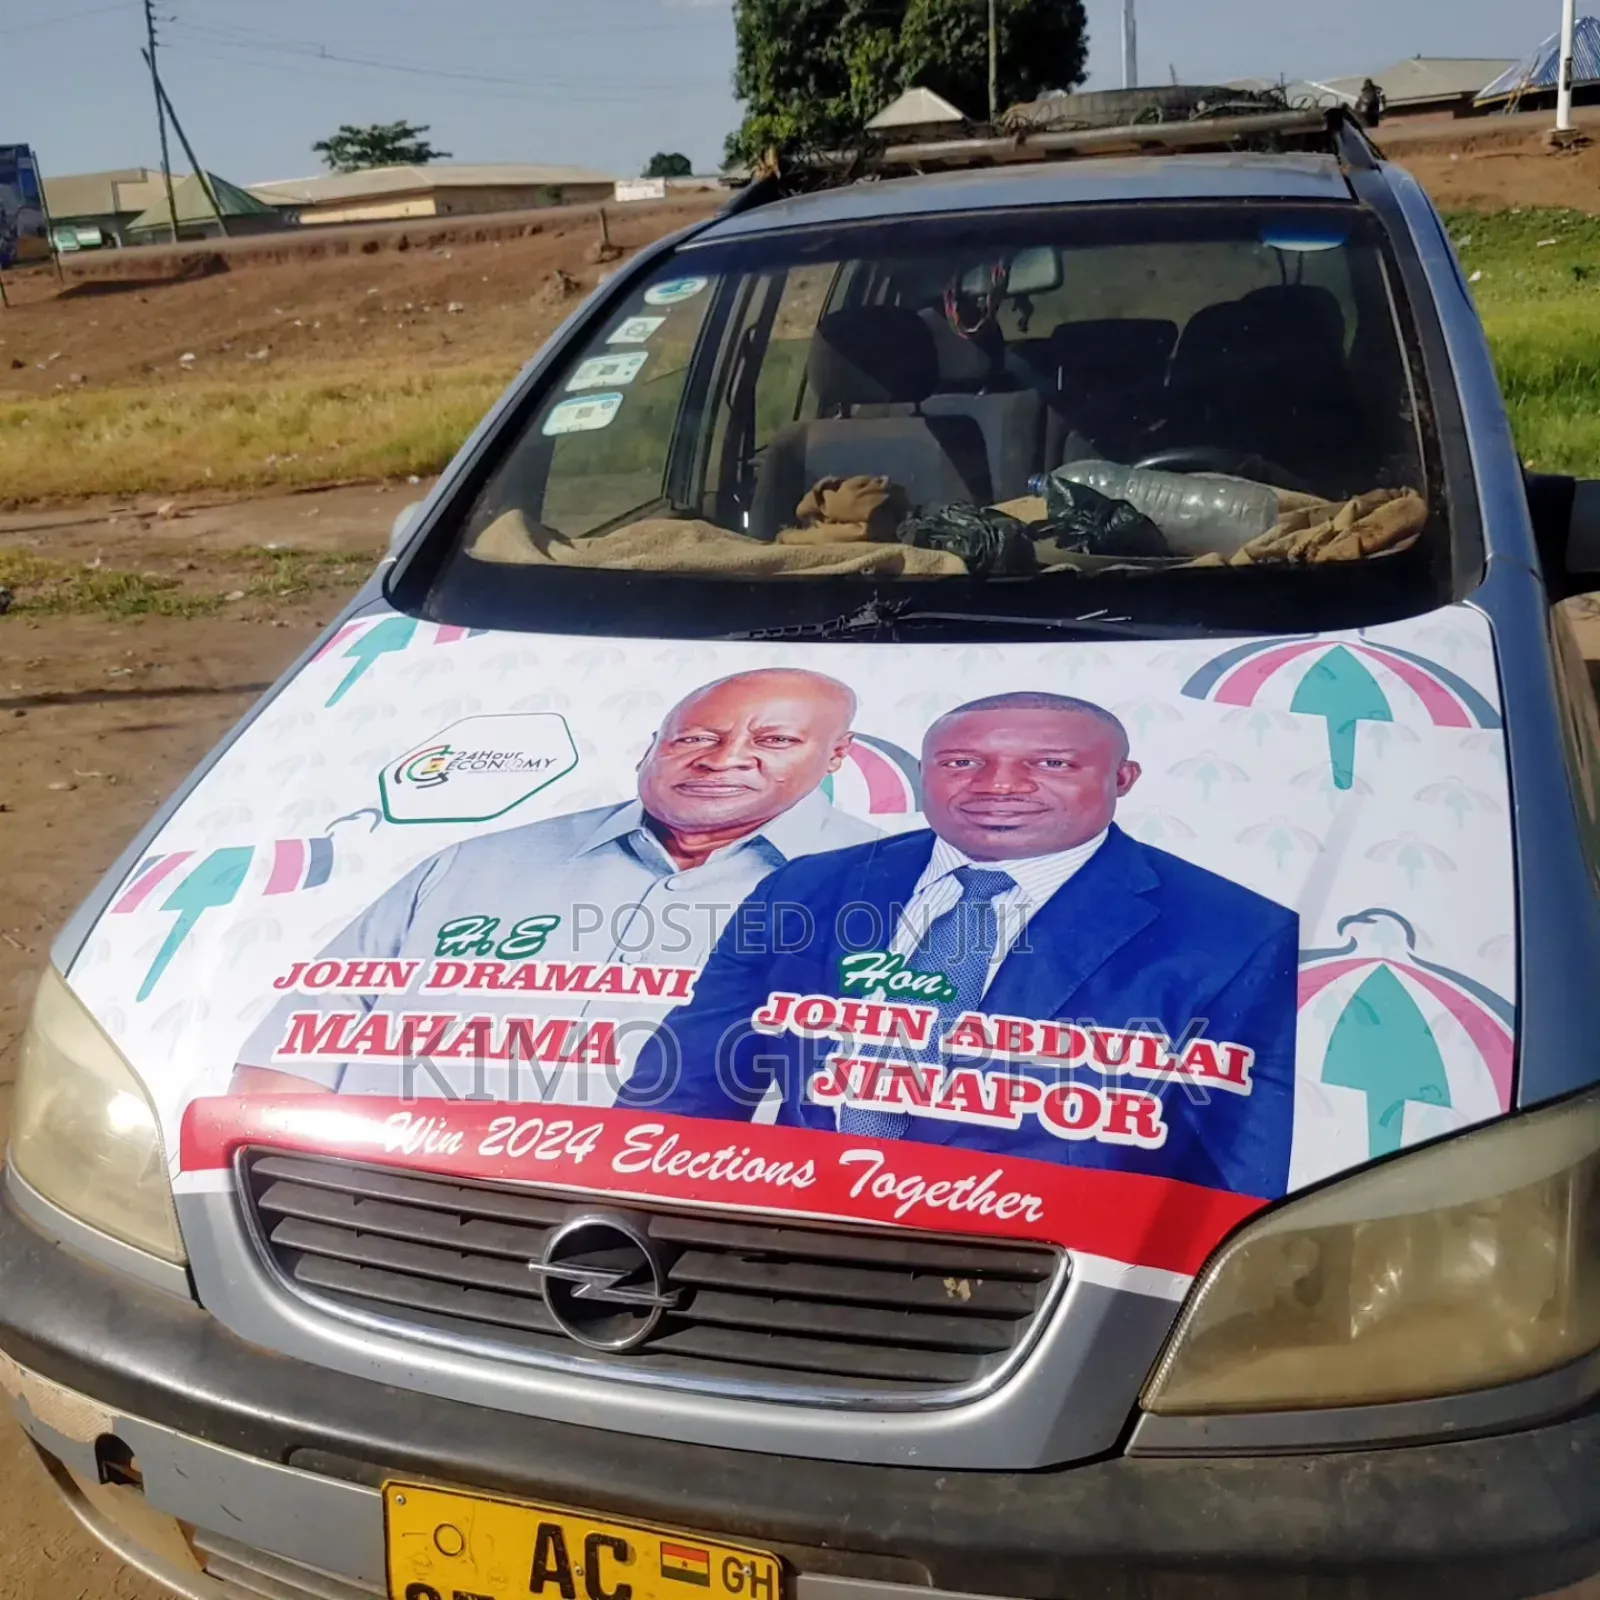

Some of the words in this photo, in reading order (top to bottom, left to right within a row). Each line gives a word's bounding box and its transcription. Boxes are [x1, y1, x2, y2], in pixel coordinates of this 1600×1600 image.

[453, 750, 524, 761] 24Hour
[273, 962, 419, 989] JOHN
[425, 962, 697, 998] DRAMANI
[838, 952, 954, 996] Hon.
[277, 1013, 621, 1066] MAHAMA
[758, 996, 936, 1042] JOHN
[944, 1016, 1253, 1087] ABDULAI
[813, 1057, 1162, 1139] JINAPOR
[384, 1111, 464, 1156] Win
[478, 1115, 605, 1165] 2024
[612, 1124, 817, 1189] Elections
[838, 1148, 1044, 1222] Together
[529, 1521, 633, 1600] AC
[720, 1555, 773, 1600] GH
